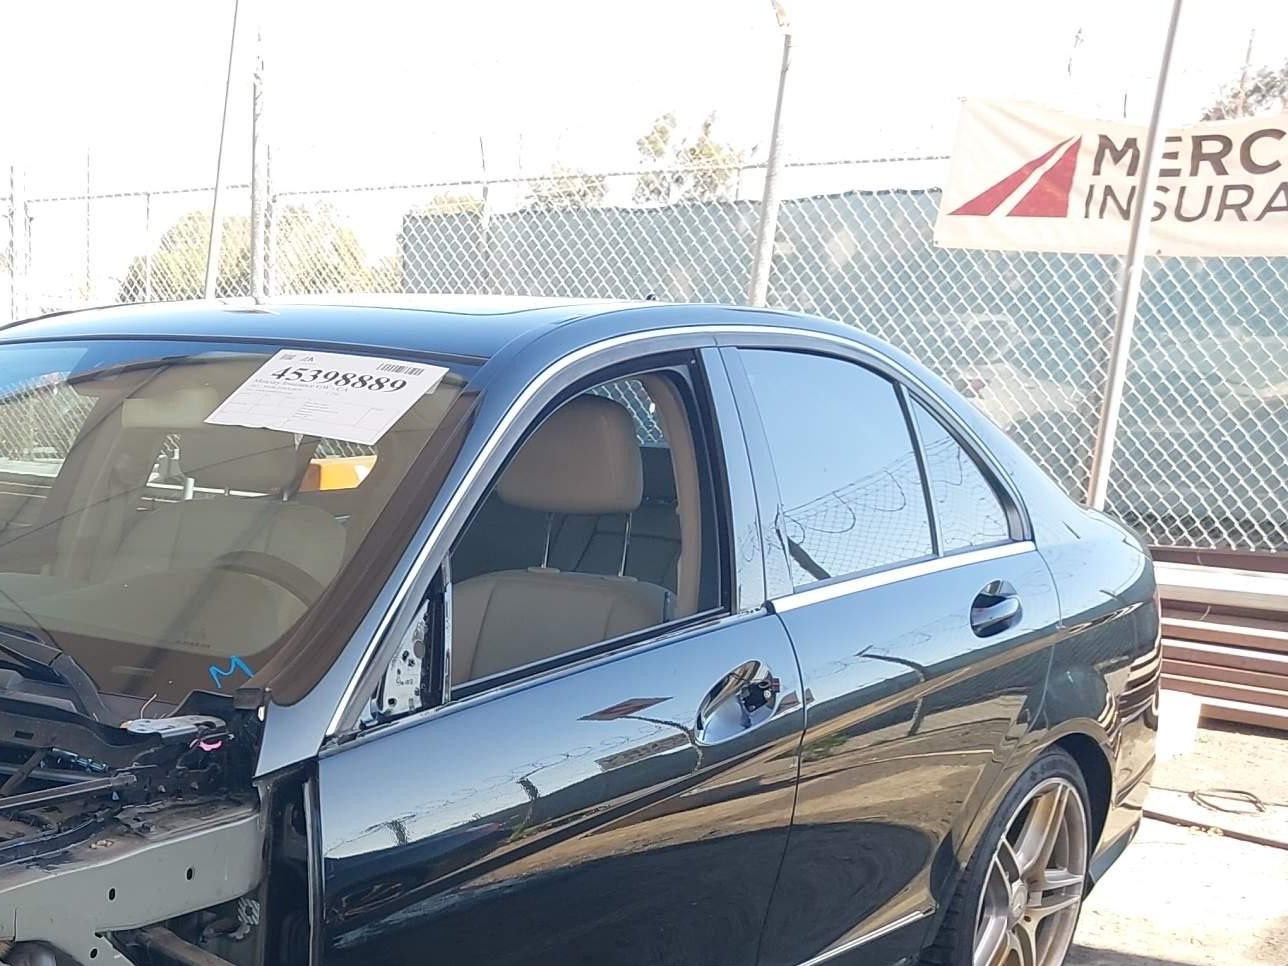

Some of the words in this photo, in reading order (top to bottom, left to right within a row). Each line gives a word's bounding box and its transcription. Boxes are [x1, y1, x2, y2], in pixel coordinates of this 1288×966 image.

[1092, 128, 1287, 177] MERC
[1084, 181, 1288, 222] INSURA
[270, 366, 408, 394] 45398889
[209, 655, 254, 688] M
